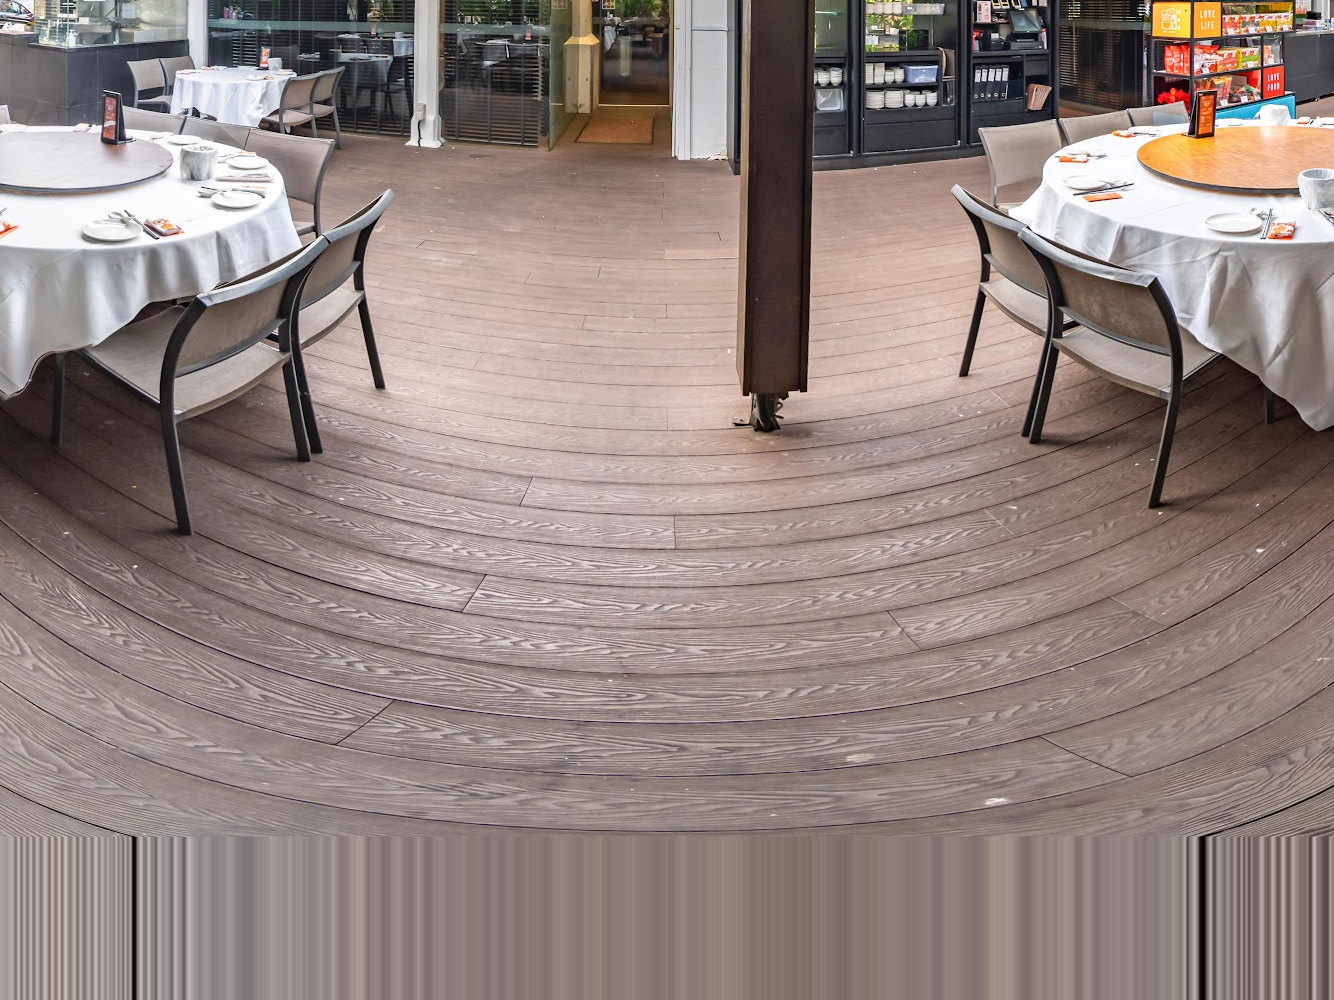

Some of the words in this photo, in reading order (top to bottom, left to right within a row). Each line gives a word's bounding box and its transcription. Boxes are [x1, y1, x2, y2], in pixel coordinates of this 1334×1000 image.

[1199, 9, 1215, 19] LOVE
[1200, 20, 1215, 30] LIFE
[1267, 72, 1280, 82] LOVE
[1267, 82, 1280, 91] FOOD
